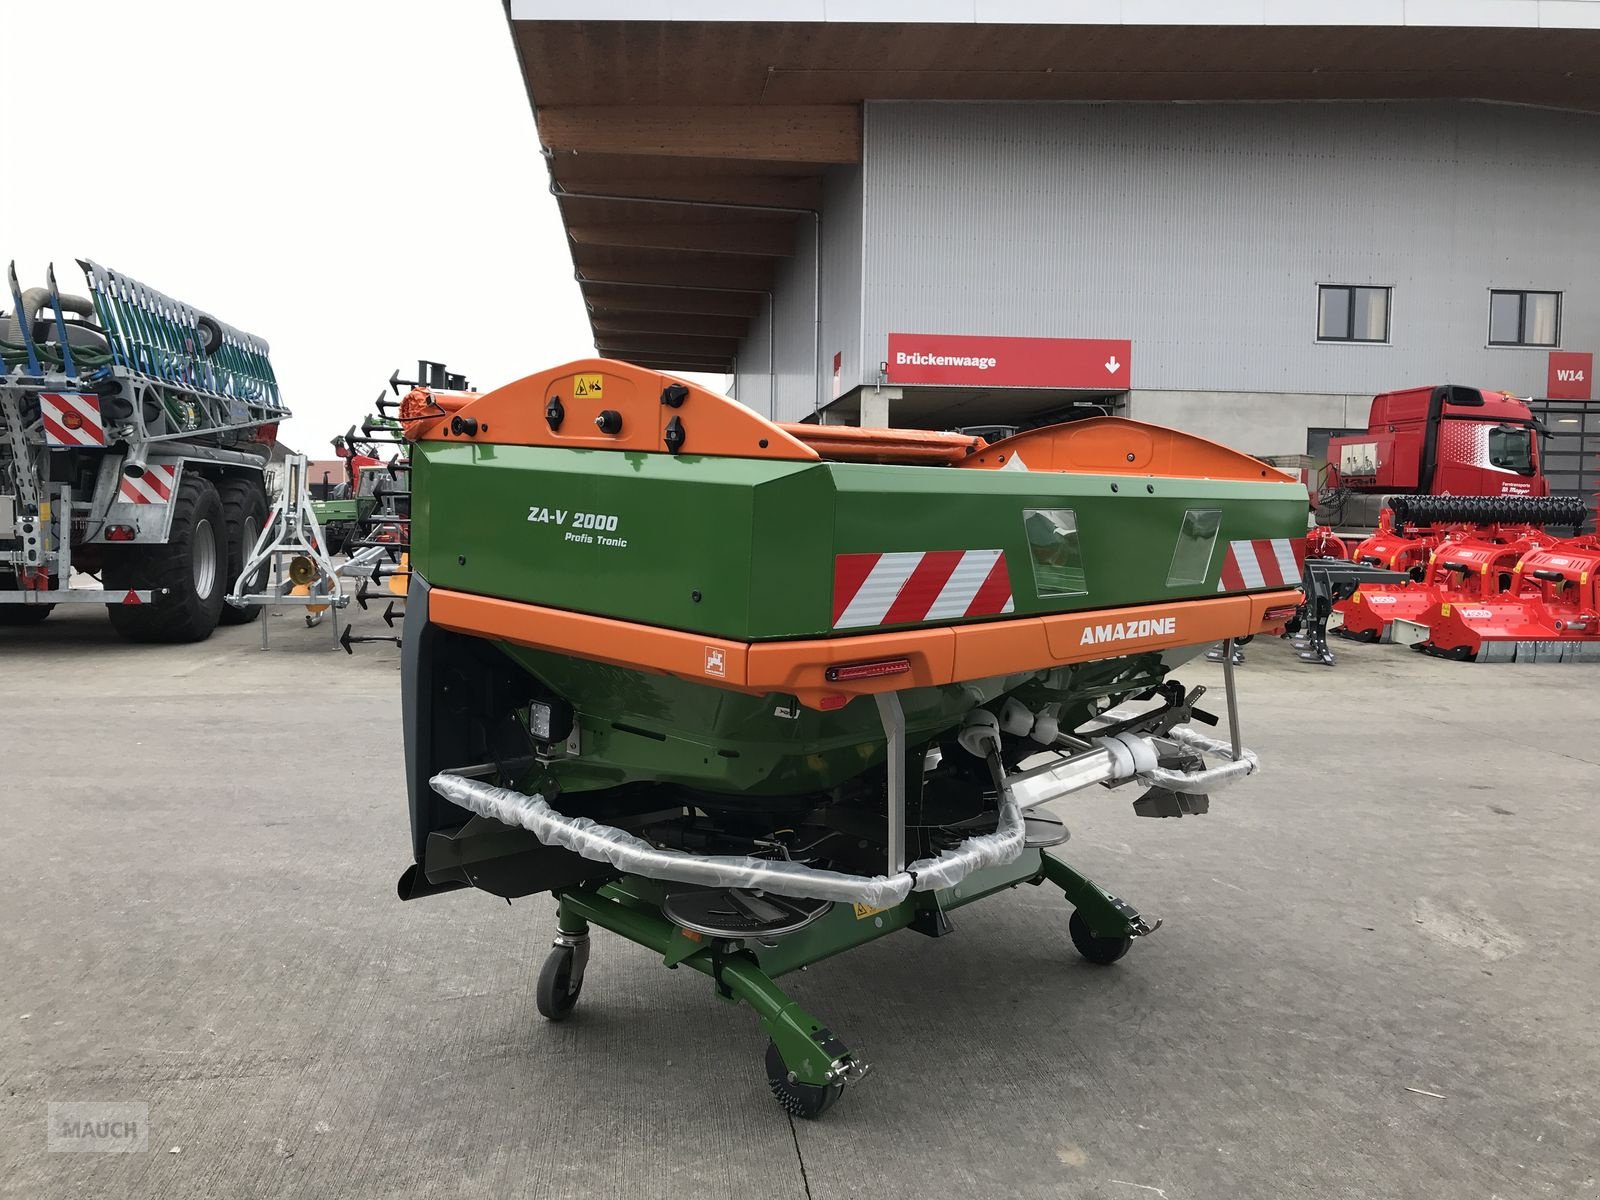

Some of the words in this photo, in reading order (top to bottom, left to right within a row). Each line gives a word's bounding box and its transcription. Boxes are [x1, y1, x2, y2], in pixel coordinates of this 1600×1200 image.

[896, 352, 996, 369] Brückenwaage
[1557, 369, 1585, 382] W14
[527, 506, 568, 525] ZA-V
[572, 512, 619, 532] 2000
[564, 532, 594, 544] Profis
[597, 535, 628, 548] Tronic
[1080, 617, 1176, 646] AMAZONE
